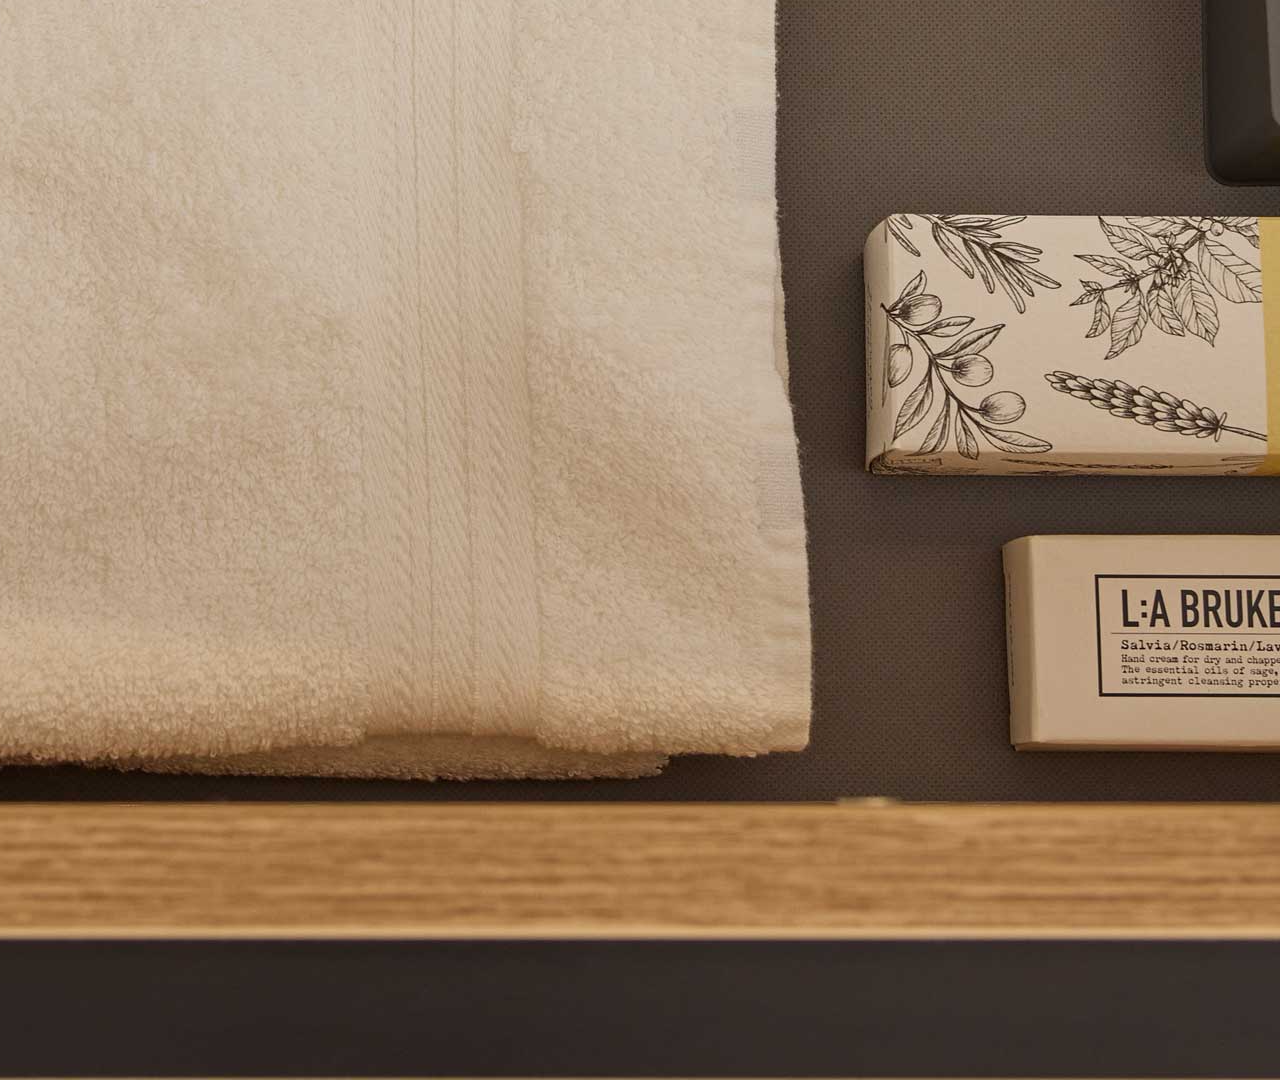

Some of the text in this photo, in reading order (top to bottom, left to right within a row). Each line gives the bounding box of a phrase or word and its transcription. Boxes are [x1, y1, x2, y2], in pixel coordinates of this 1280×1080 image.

[1121, 589, 1170, 628] L:A
[1121, 655, 1145, 663] Hand
[1183, 655, 1199, 664] for
[1204, 656, 1220, 666] dry
[1225, 656, 1242, 664] and
[1146, 666, 1199, 675] essential
[1204, 667, 1228, 675] oils
[1233, 667, 1245, 675] of
[1250, 668, 1278, 678] sage,
[1121, 677, 1182, 686] astringent
[1188, 677, 1243, 687] cleansing
